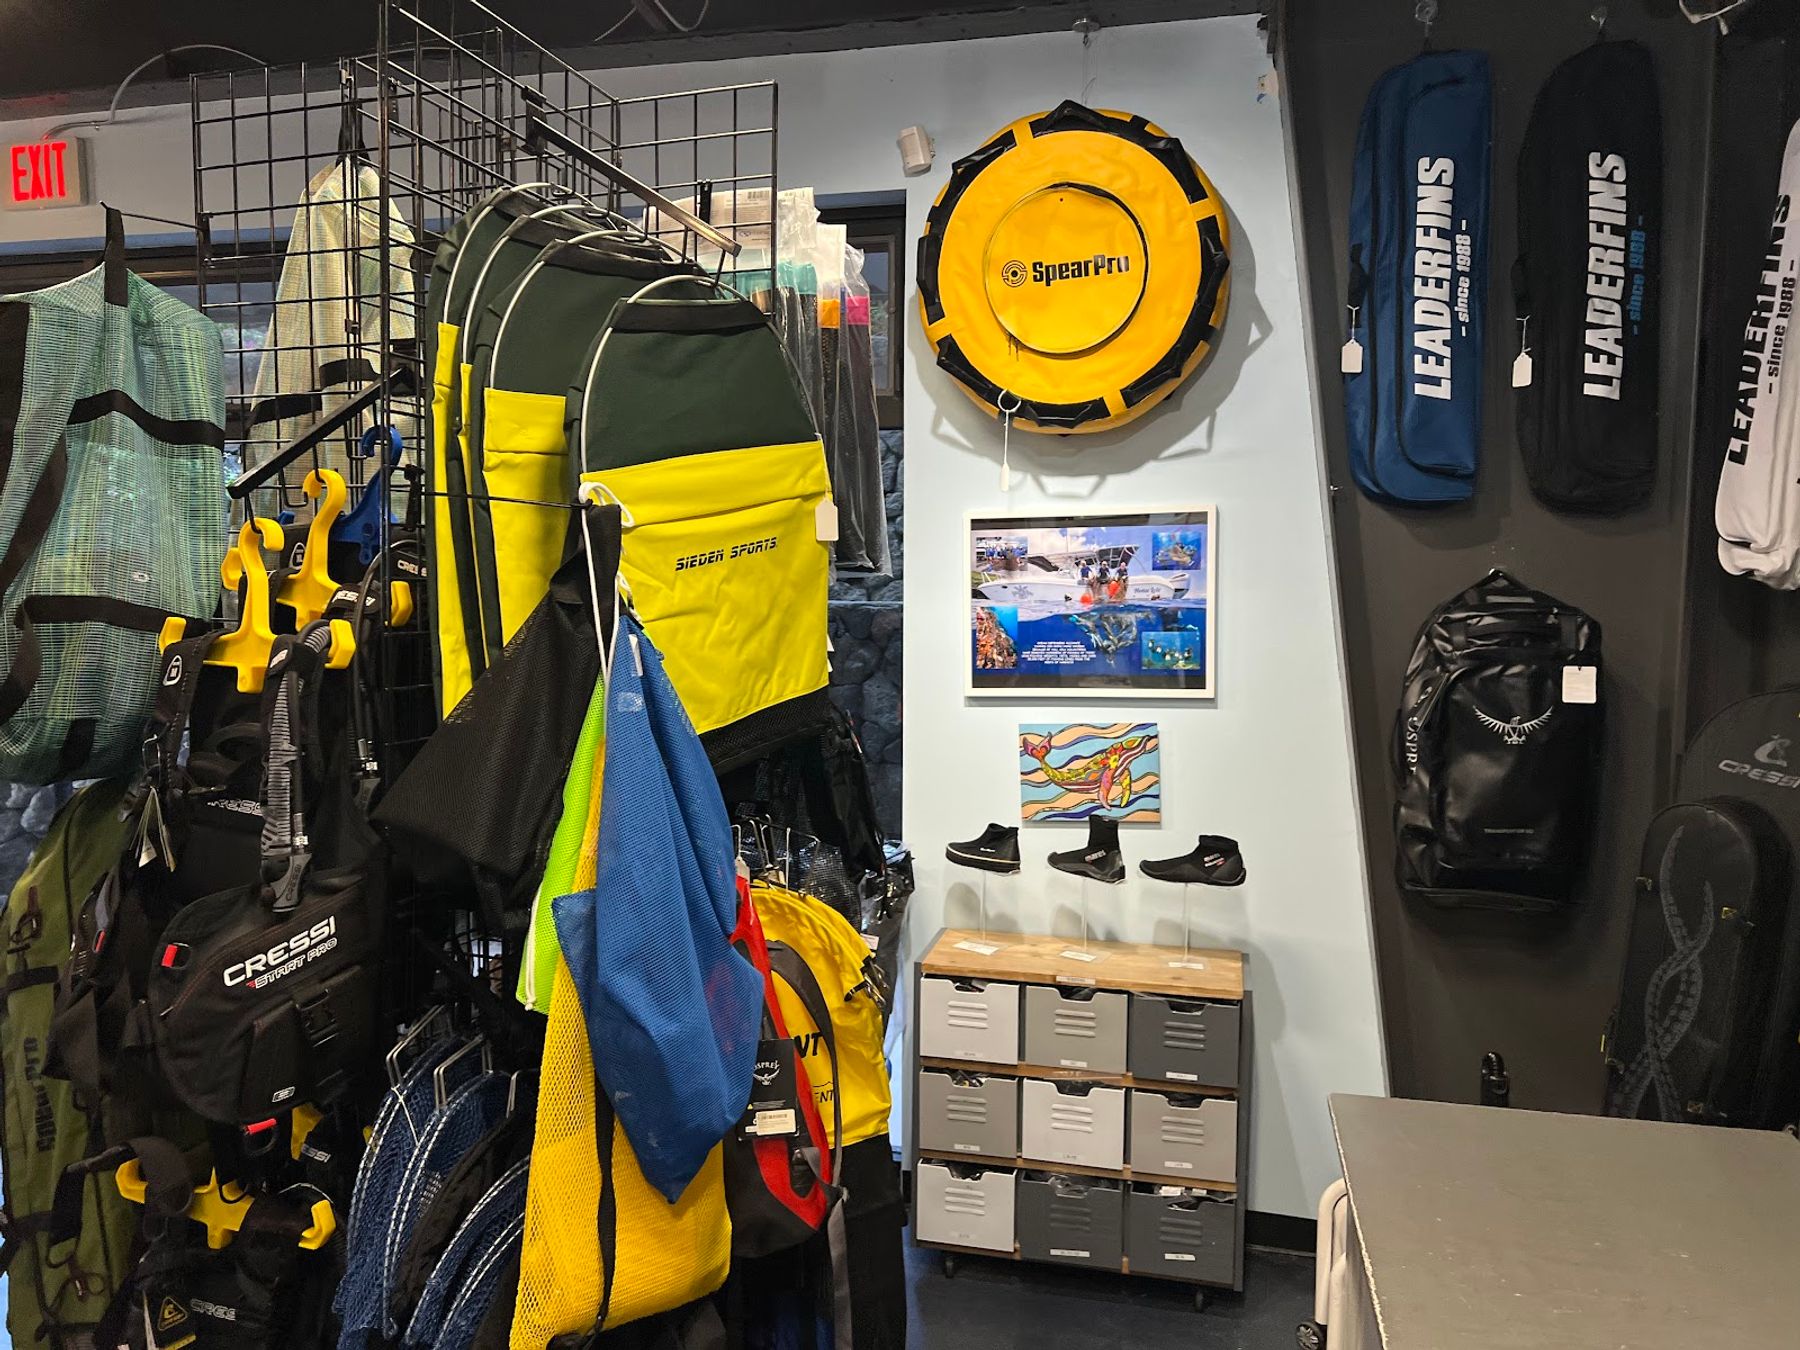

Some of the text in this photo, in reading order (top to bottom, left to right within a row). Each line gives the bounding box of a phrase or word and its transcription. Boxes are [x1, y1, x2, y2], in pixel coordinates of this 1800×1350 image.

[11, 142, 67, 202] EXIT
[1031, 254, 1130, 287] SpearPro
[1414, 156, 1455, 400] LEADERFINS
[1455, 233, 1472, 323] since 1988
[1583, 151, 1627, 400] LEADERFINS
[1626, 273, 1645, 322] since
[1767, 276, 1796, 378] since 1988
[223, 915, 337, 987] CRESSI
[255, 937, 337, 989] START PRO
